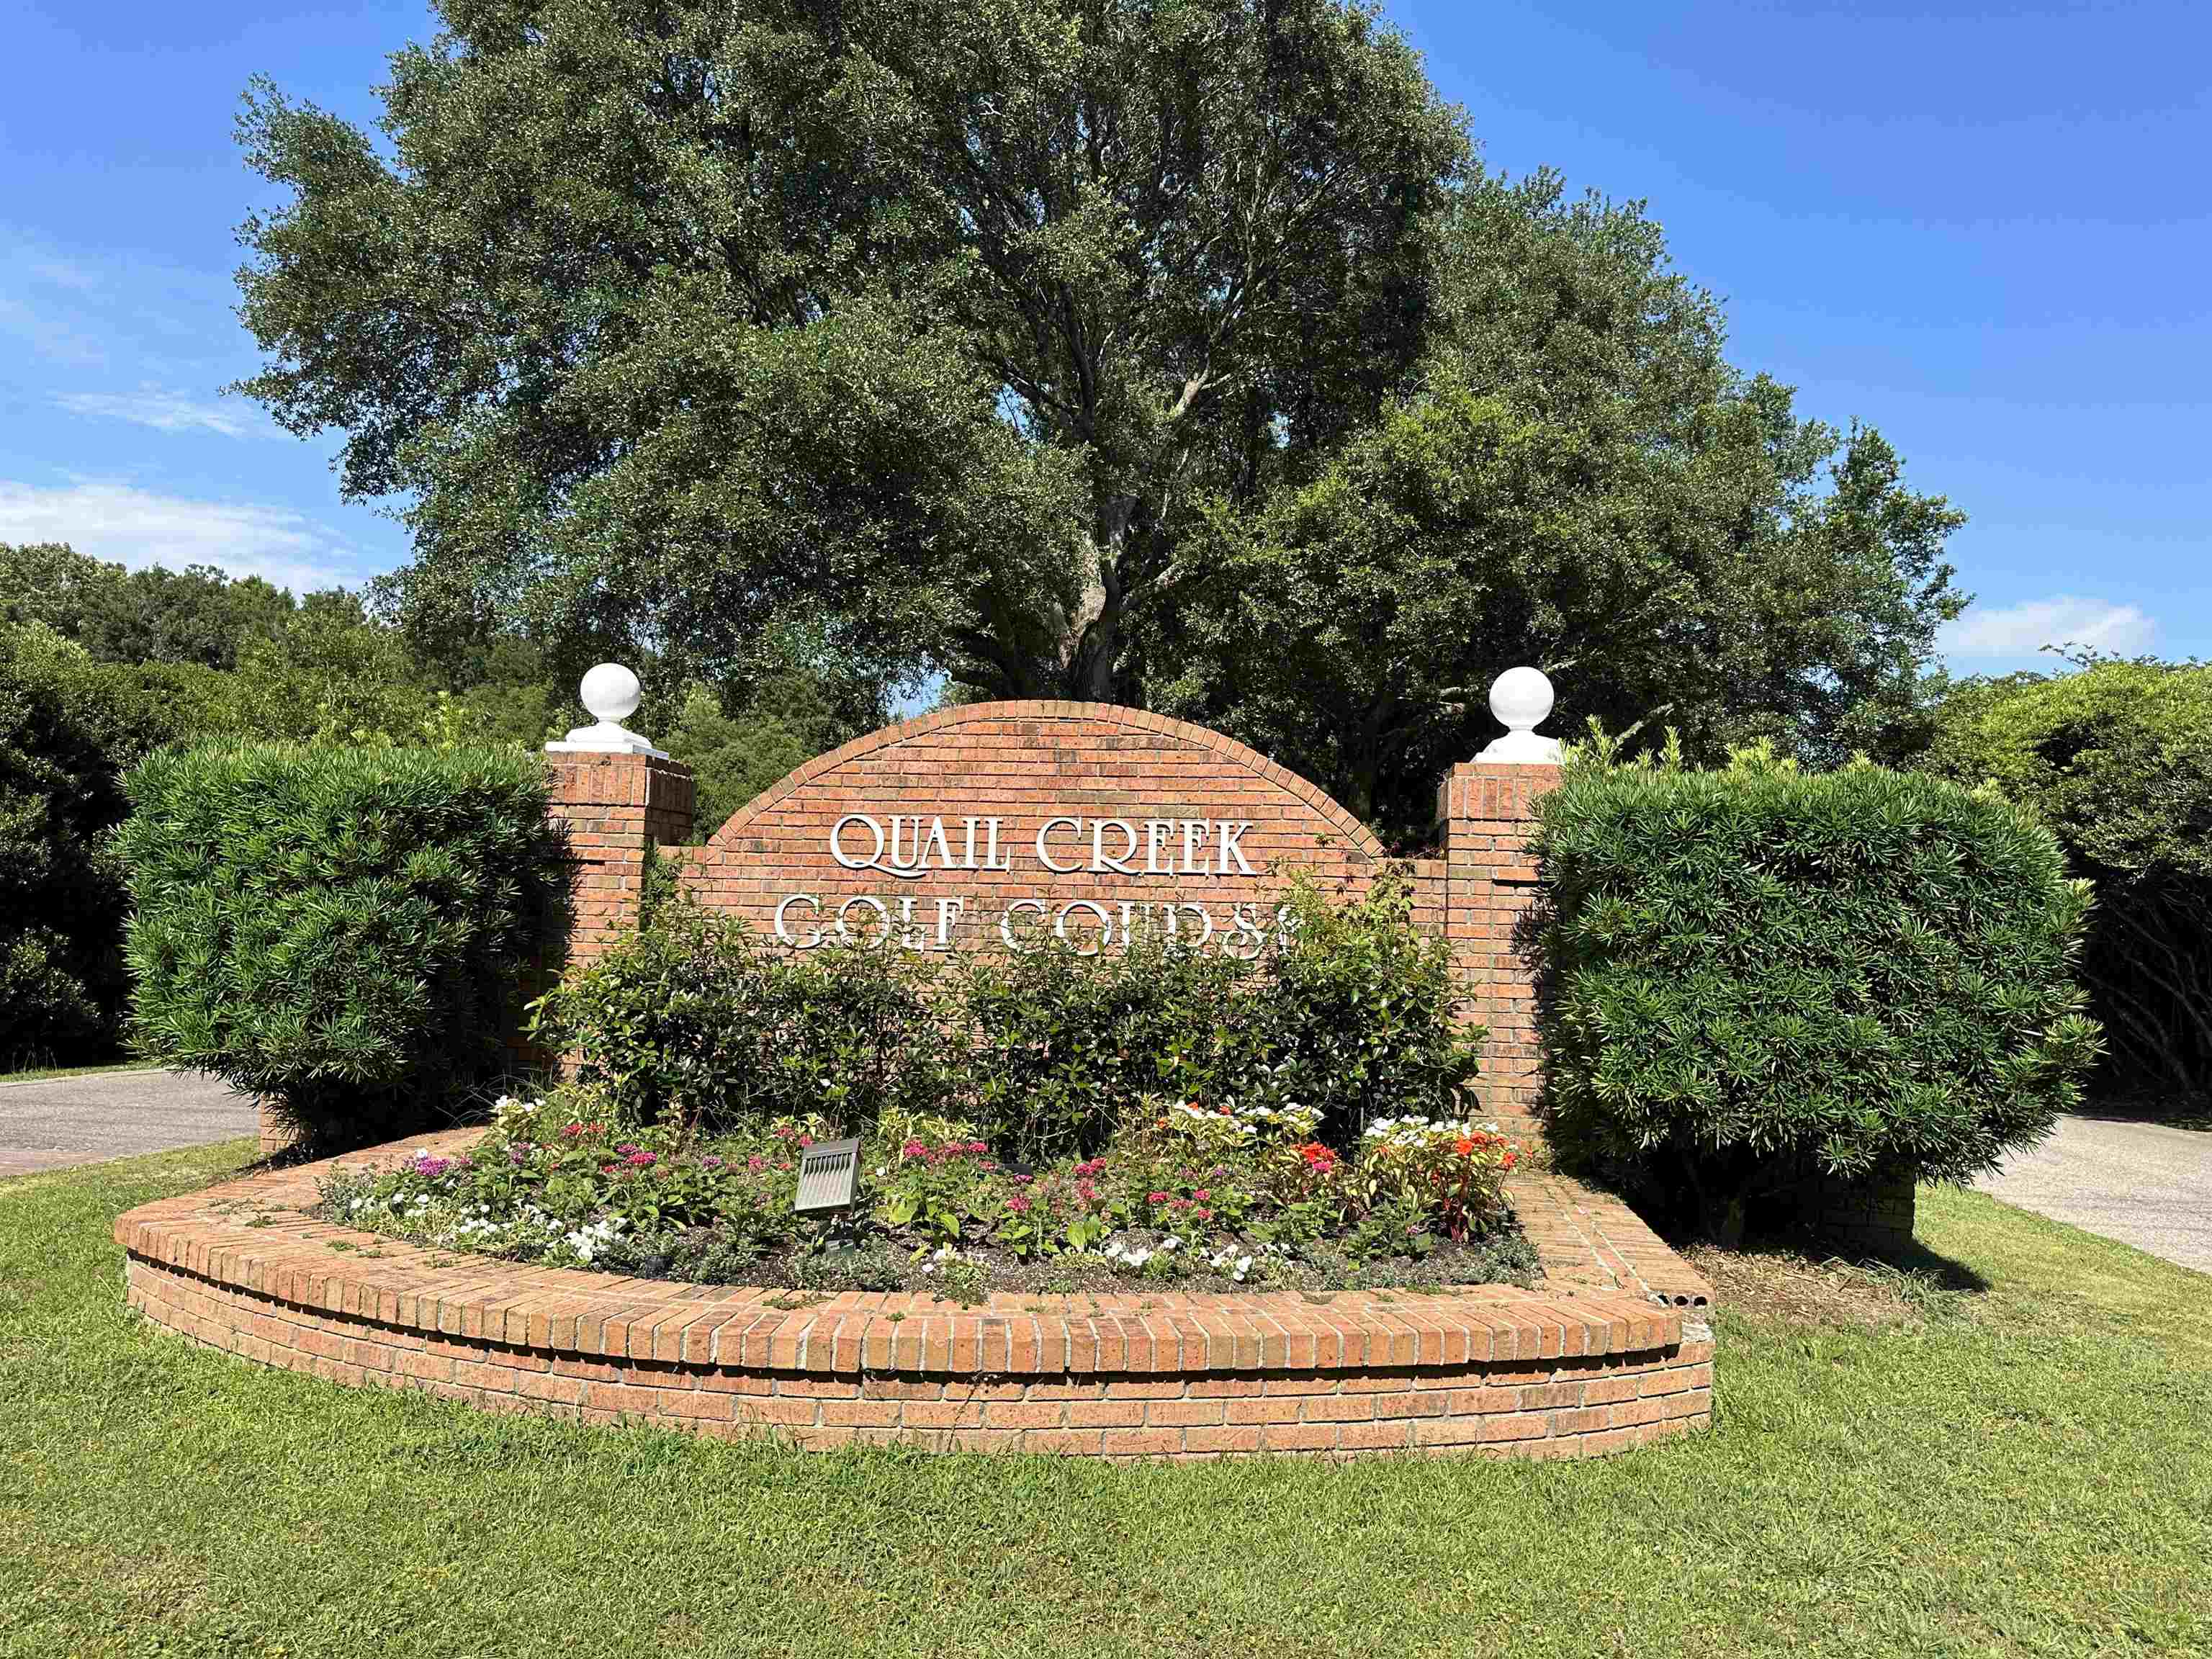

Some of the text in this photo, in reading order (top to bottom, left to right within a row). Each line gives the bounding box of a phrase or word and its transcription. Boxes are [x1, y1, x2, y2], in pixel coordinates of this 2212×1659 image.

[830, 814, 1257, 878] QUAIL CREEK
[774, 894, 963, 952] GOLF
